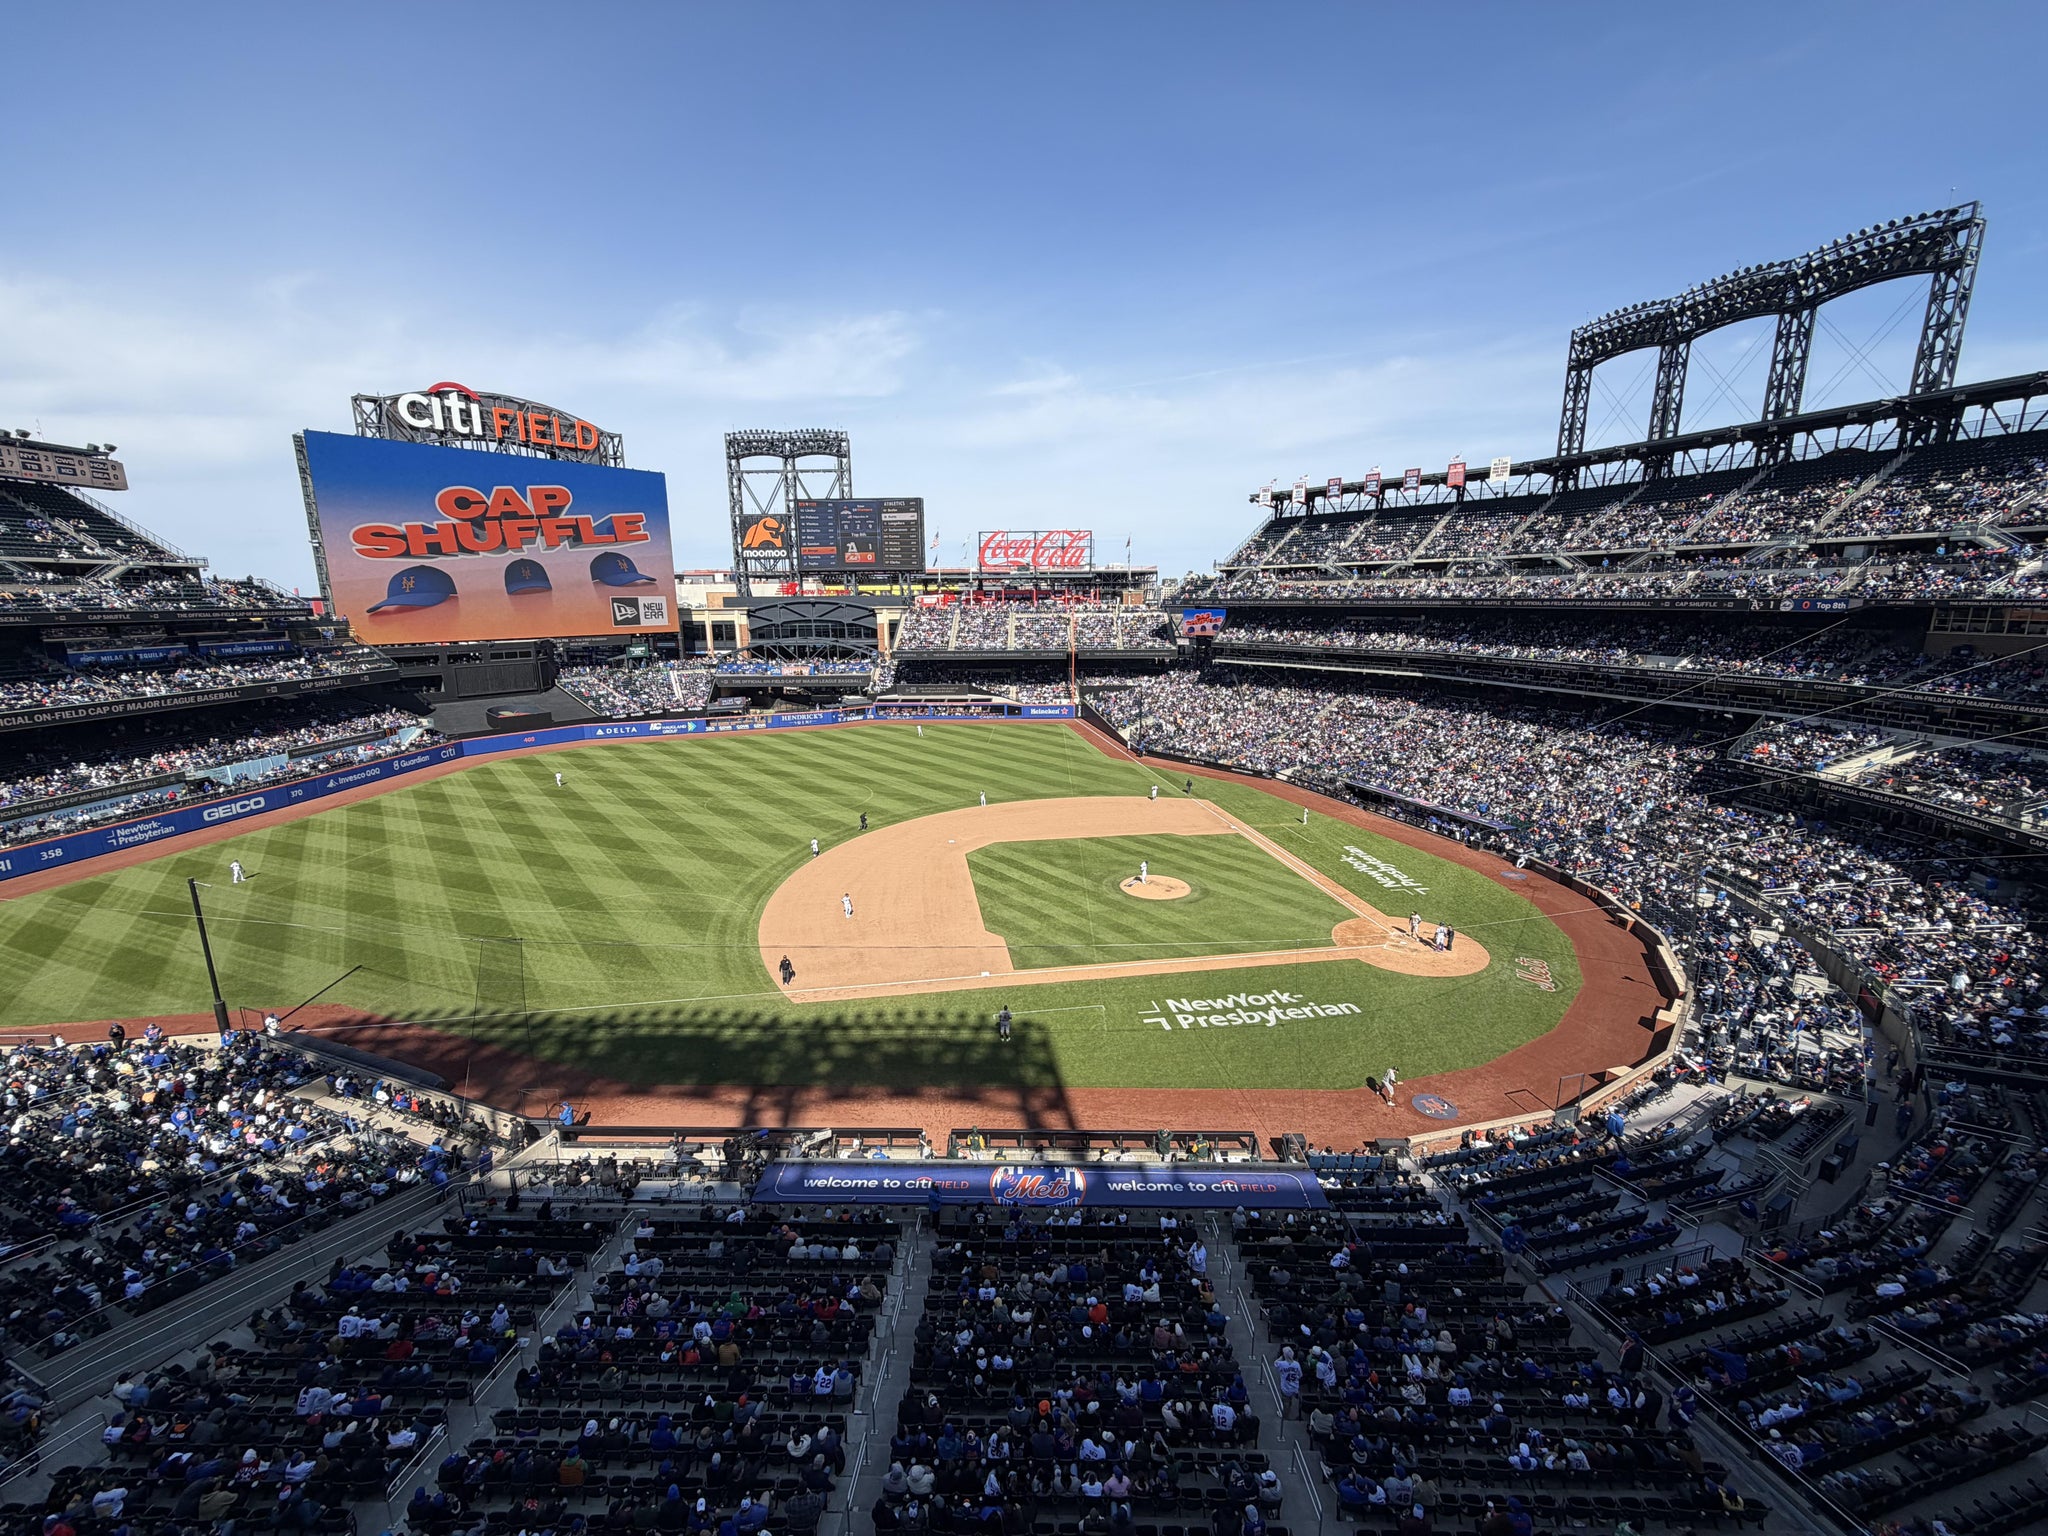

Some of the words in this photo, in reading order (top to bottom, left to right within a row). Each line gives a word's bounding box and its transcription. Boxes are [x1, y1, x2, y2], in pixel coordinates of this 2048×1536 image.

[397, 382, 482, 436] citi
[492, 407, 599, 451] FIELD
[436, 486, 572, 520] CAP
[350, 514, 650, 560] SHUFFLE
[643, 602, 664, 612] NEW
[1816, 602, 1831, 610] Top
[644, 611, 664, 620] ERA
[315, 678, 342, 688] SHUFFLE
[0, 714, 32, 726] ICIAL
[34, 709, 86, 722] ON-FIELD
[88, 706, 110, 716] CAP
[112, 704, 124, 713] OF
[126, 701, 160, 712] MAJOR
[162, 696, 196, 706] LEAGUE
[197, 690, 241, 702] BASEBALL
[2019, 705, 2048, 714] BASEBA
[440, 745, 456, 760] citi
[400, 755, 430, 768] Guardian
[339, 773, 365, 785] Invesco
[366, 768, 380, 777] QQQ
[1765, 769, 1788, 779] SHUFFLE
[290, 789, 303, 798] 370
[0, 808, 20, 817] ICIAL
[203, 796, 266, 822] GEICO
[1831, 783, 1858, 795] OFFICIAL
[1859, 791, 1889, 802] ON-FIELD
[1890, 797, 1905, 806] CAP
[1915, 804, 1935, 813] MAJOR
[1934, 809, 1957, 821] LEAGUE
[1958, 816, 1992, 831] BASEBALL
[117, 821, 161, 837] NewYork-
[119, 826, 174, 845] Presbyterian
[2029, 839, 2045, 848] CAP
[40, 848, 64, 861] 358
[1515, 957, 1556, 992] Mets
[1166, 989, 1303, 1014] NewYork-
[1176, 1001, 1360, 1030] Presbyterian
[804, 1176, 878, 1188] welcome
[883, 1178, 900, 1188] to
[906, 1176, 931, 1189] citi
[935, 1180, 969, 1189] FIELD
[1005, 1175, 1070, 1198] Mets
[1108, 1181, 1183, 1192] welcome
[1188, 1182, 1206, 1192] to
[1212, 1180, 1238, 1192] citi
[1241, 1184, 1277, 1192] FIELD
[821, 1377, 831, 1388] 22
[1218, 1416, 1226, 1426] 12
